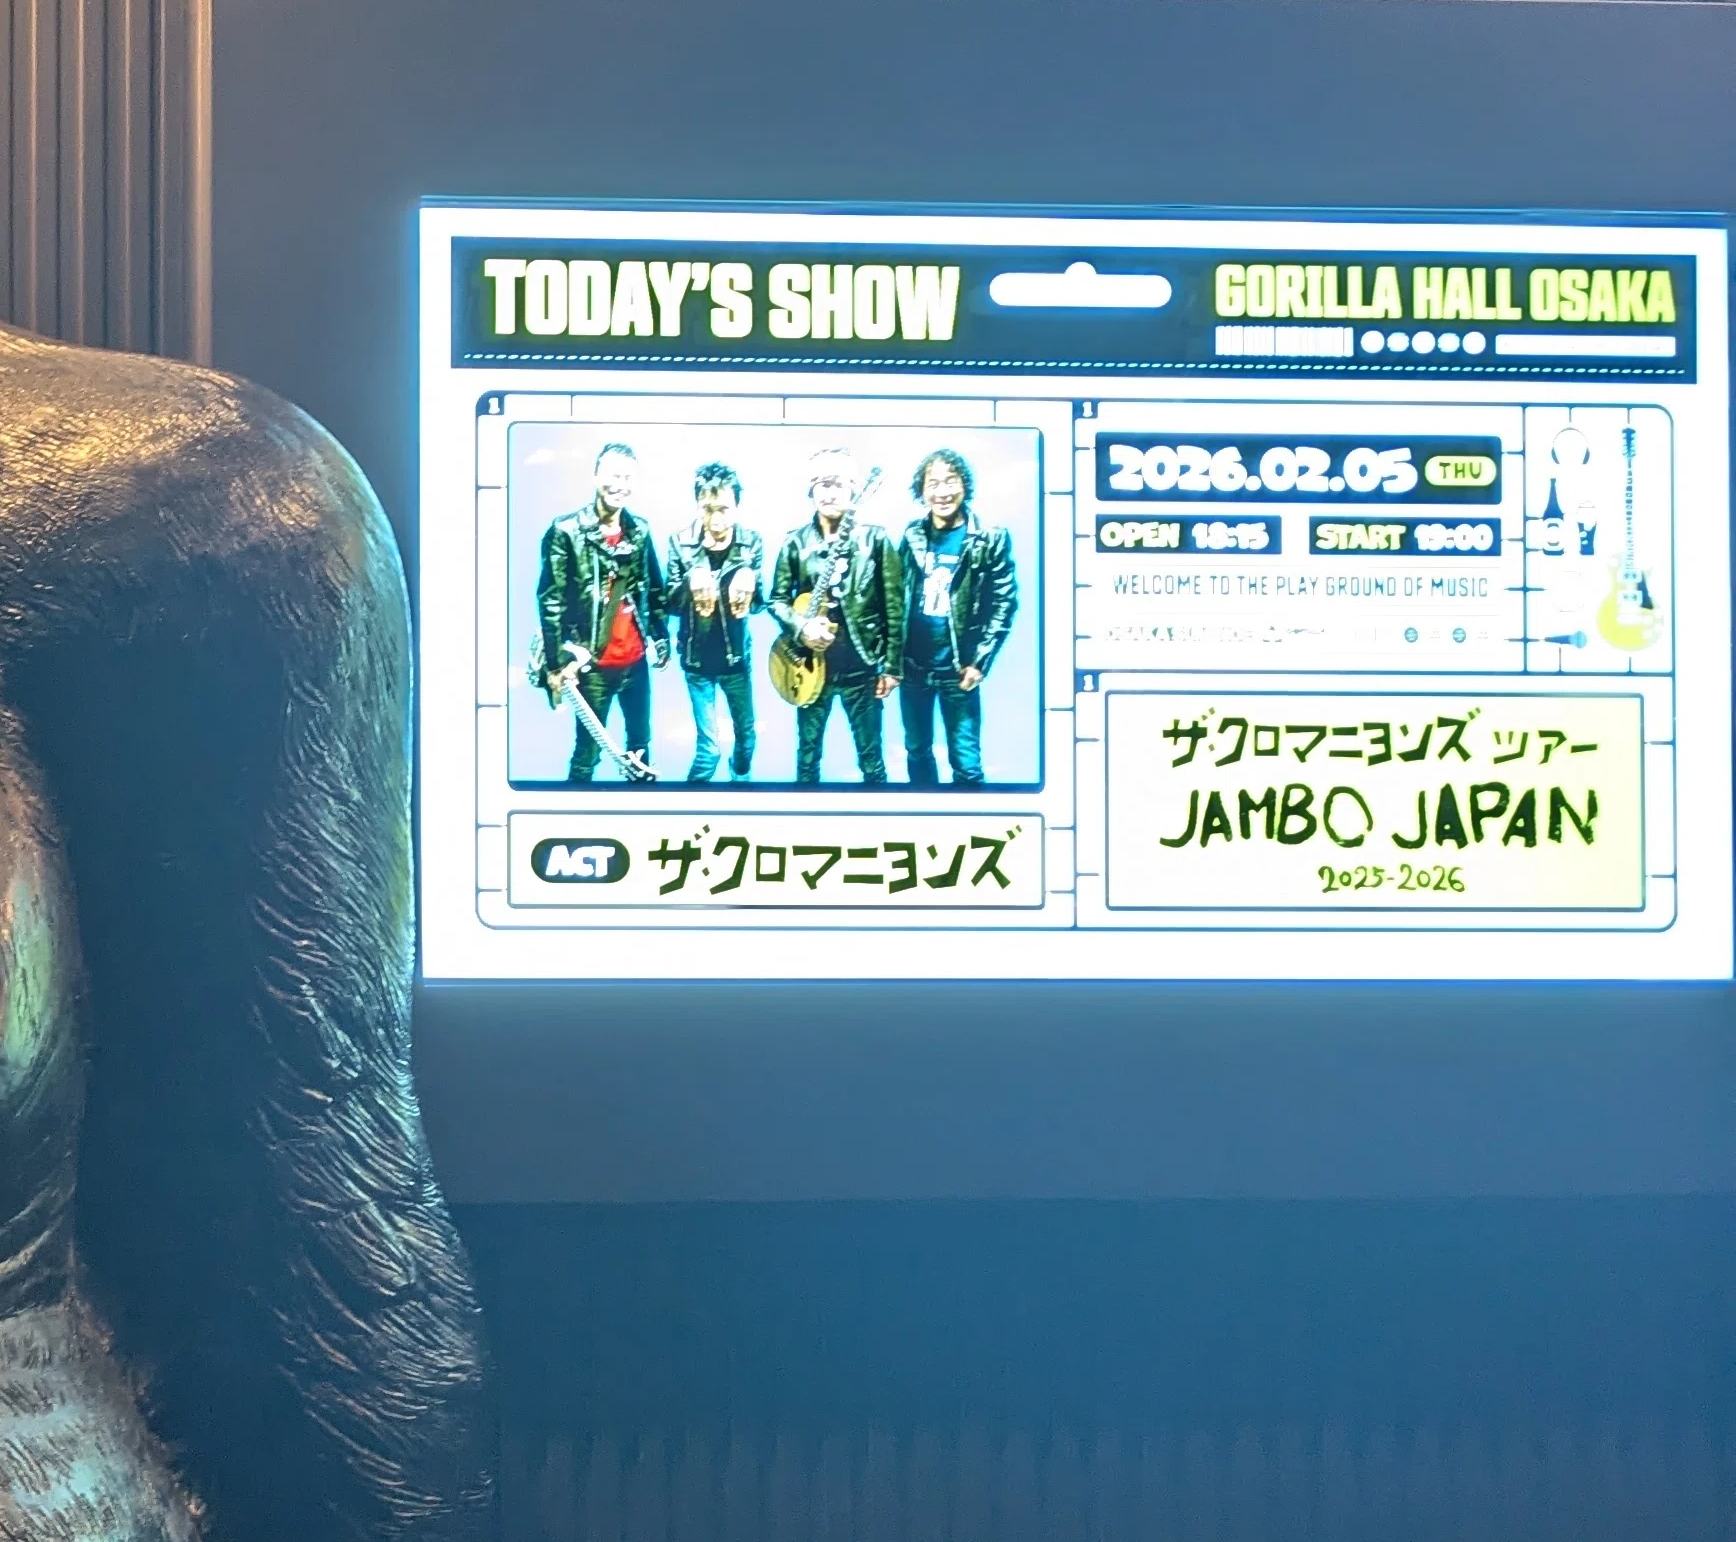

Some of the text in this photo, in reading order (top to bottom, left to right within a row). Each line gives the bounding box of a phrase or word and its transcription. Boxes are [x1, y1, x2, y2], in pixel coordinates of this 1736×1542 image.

[483, 258, 961, 341] TODAY'S SHOW
[1214, 263, 1676, 323] GORILLA HALL OSAKA
[1108, 444, 1483, 495] 2026.02.05 THU
[1100, 521, 1270, 550] OPEN 18:15
[1315, 523, 1494, 551] START 19:00
[1113, 574, 1488, 598] WELCOME TO THE PLAY GROUND OF MUSIC
[1159, 782, 1599, 850] JAMBO JAPAN
[545, 844, 616, 877] ACT
[1317, 862, 1465, 893] 2025-2026
